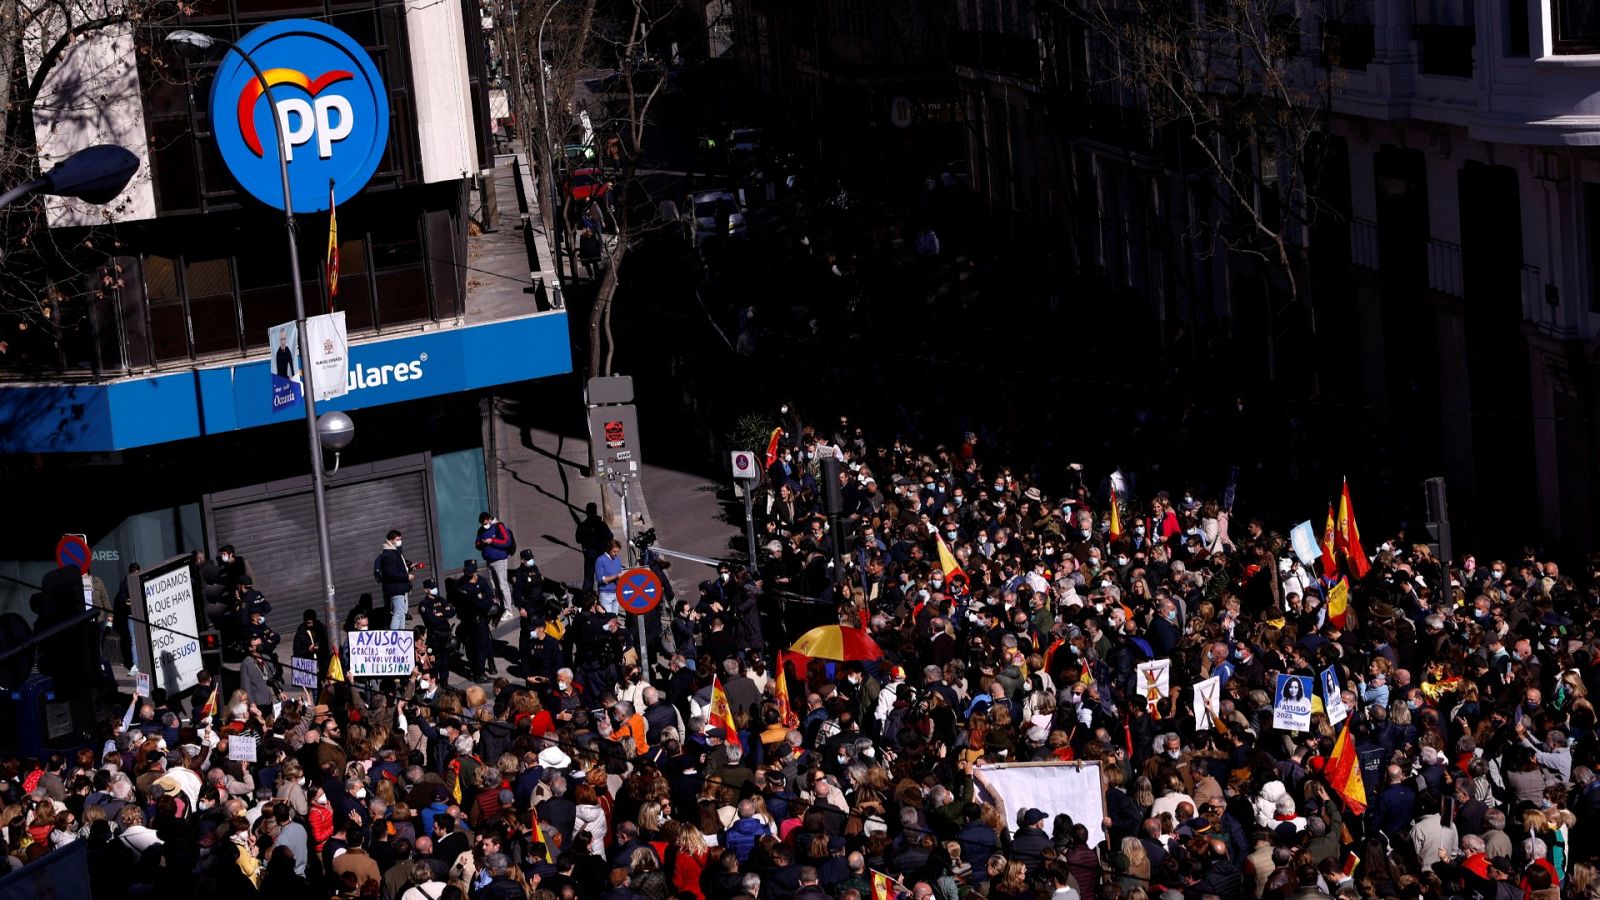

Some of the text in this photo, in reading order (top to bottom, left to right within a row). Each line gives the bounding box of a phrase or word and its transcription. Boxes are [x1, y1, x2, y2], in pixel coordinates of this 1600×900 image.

[347, 360, 423, 391] ulares
[92, 551, 120, 561] ARES
[145, 571, 188, 597] AYUDAMOS
[148, 589, 191, 615] A QUE HAYA
[150, 612, 178, 633] MENOS
[152, 632, 175, 650] PISOS
[356, 631, 399, 646] AYUSO
[155, 641, 197, 669] EN DESUSO
[351, 647, 396, 656] GRACIAS POR
[364, 655, 409, 664] DEVOLVERNOS
[354, 663, 366, 674] LA
[1276, 712, 1293, 720] 2023
[1281, 704, 1307, 713] AYUSO
